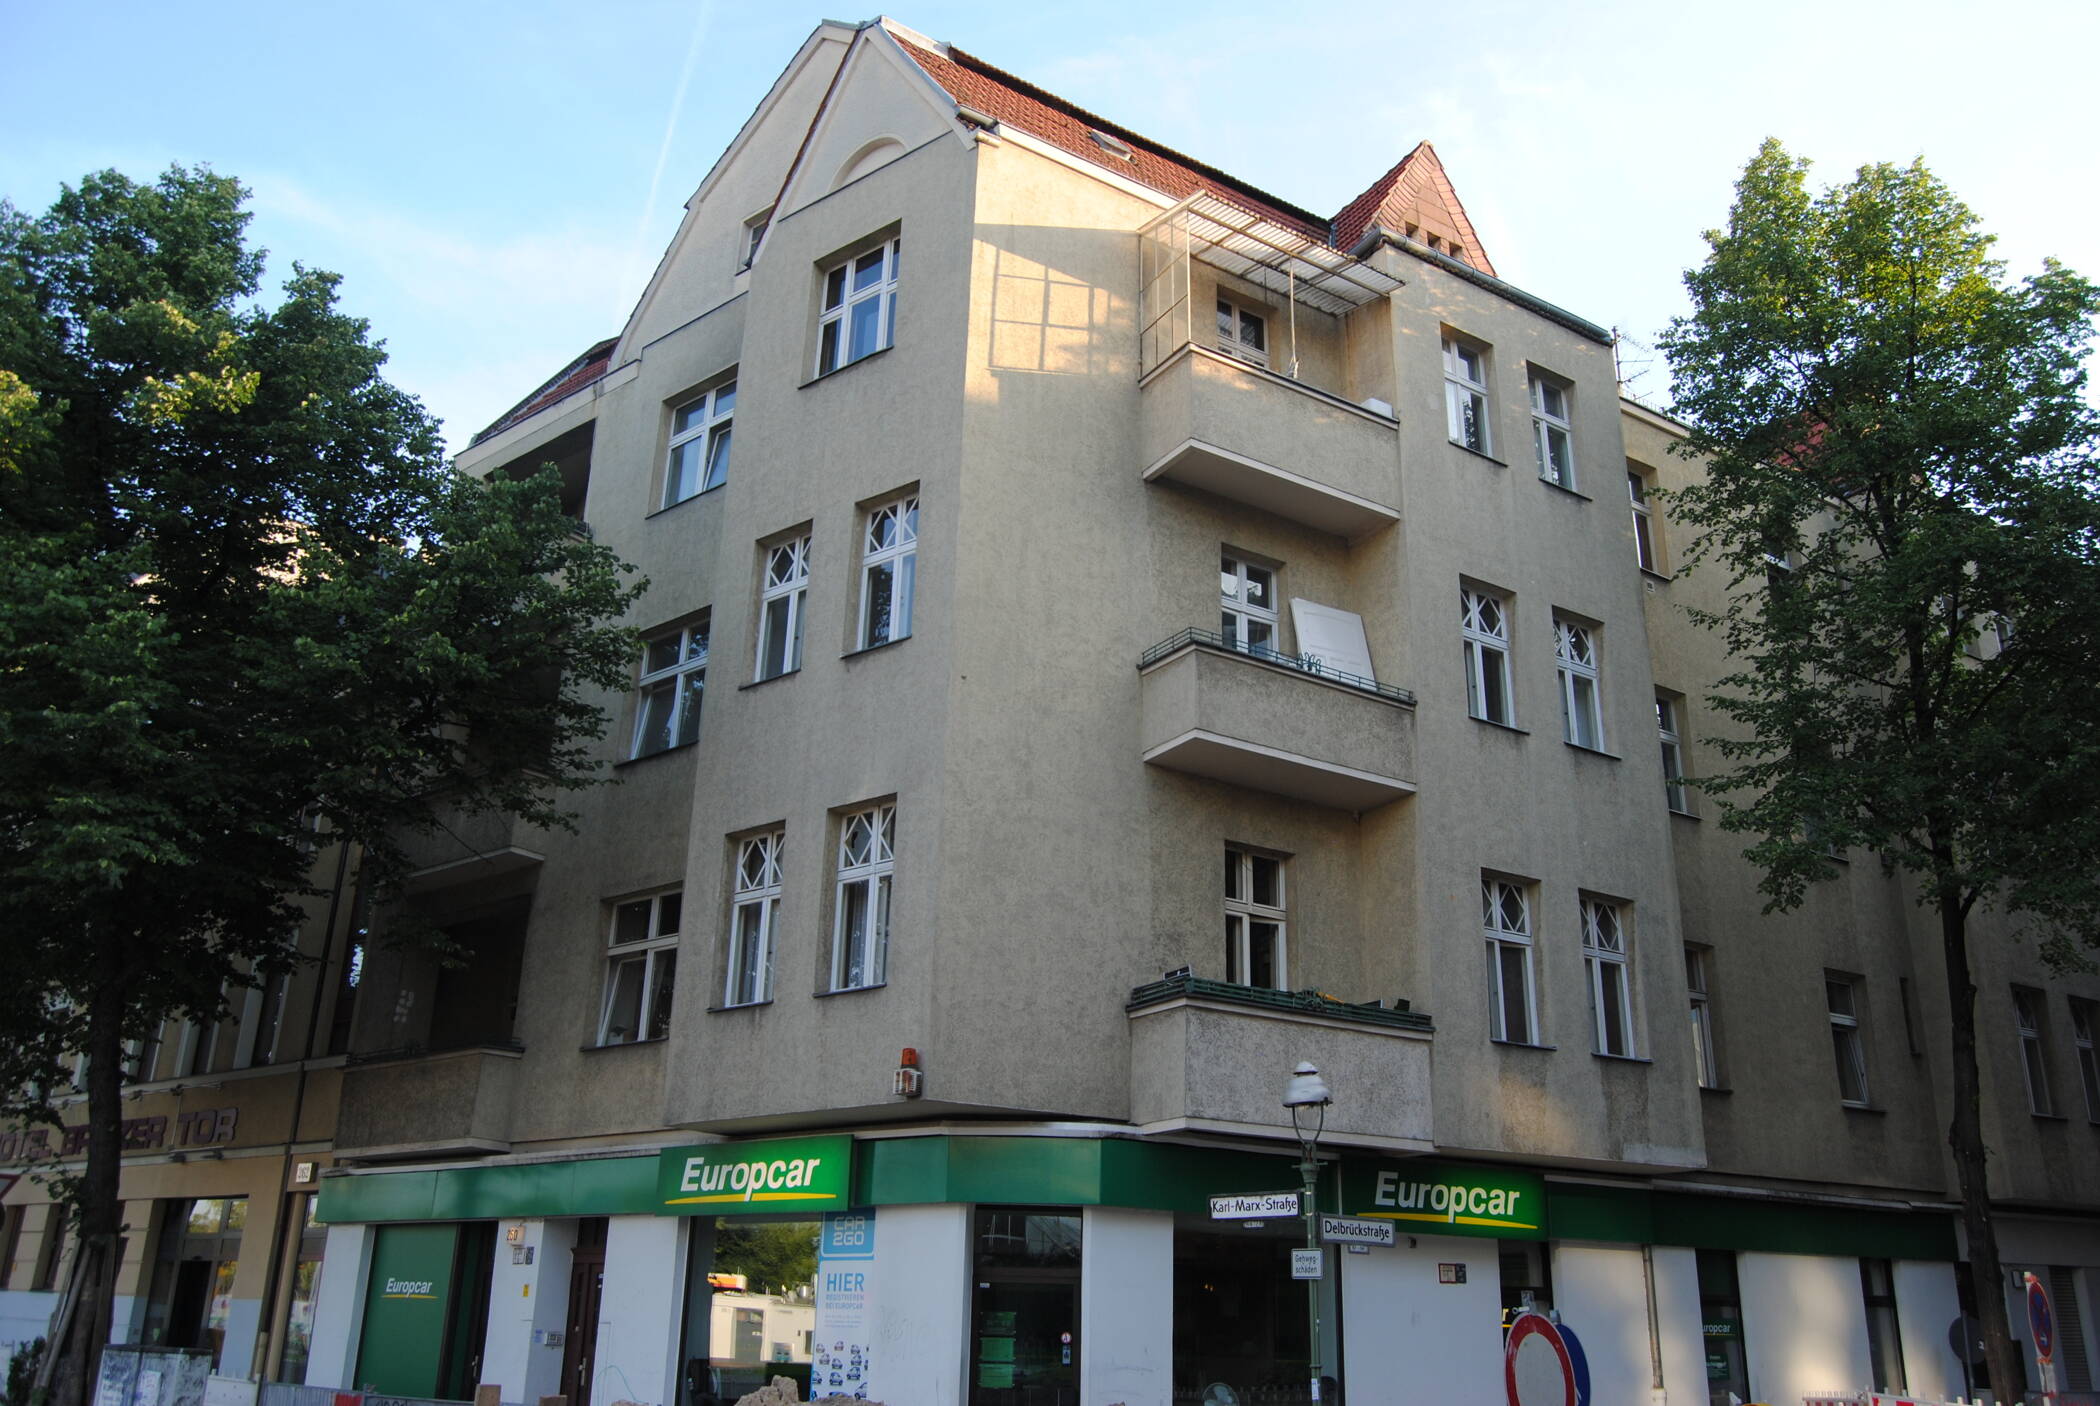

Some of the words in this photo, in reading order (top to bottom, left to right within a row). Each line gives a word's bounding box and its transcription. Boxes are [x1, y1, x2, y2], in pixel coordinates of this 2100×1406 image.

[179, 1107, 240, 1146] TOR
[680, 1156, 822, 1201] Europcar
[1212, 1196, 1297, 1213] Karl-Marx-Straße
[1374, 1170, 1521, 1224] Europcar
[833, 1216, 865, 1231] CAR
[1324, 1219, 1390, 1241] Delbrückstraße
[833, 1231, 865, 1246] 2GO
[385, 1277, 433, 1298] Europcar
[826, 1273, 865, 1292] HIER
[1703, 1324, 1731, 1336] uropcar
